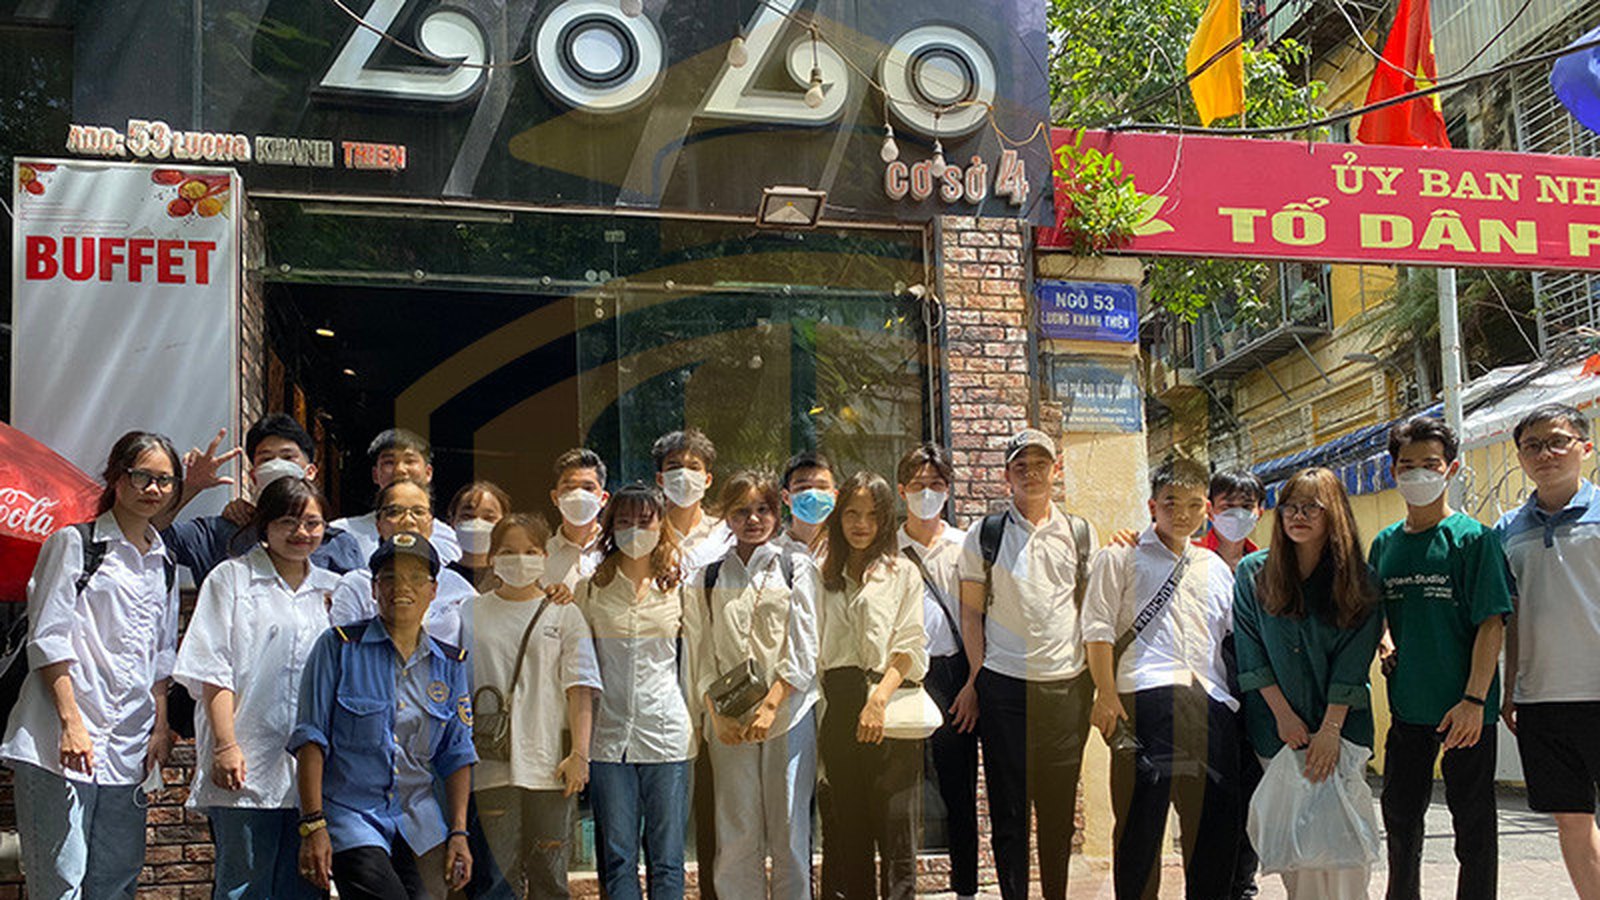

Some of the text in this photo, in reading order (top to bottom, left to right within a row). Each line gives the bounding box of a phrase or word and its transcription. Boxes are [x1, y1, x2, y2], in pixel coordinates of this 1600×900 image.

[127, 118, 172, 159] 53
[255, 135, 334, 168] KHANH
[995, 149, 1030, 206] 4
[1331, 151, 1404, 195] ỦY
[1418, 168, 1522, 201] BAN
[1218, 196, 1330, 246] TỔ
[1360, 208, 1538, 254] DÂN
[26, 235, 216, 285] BUFFET
[1093, 294, 1115, 311] 53
